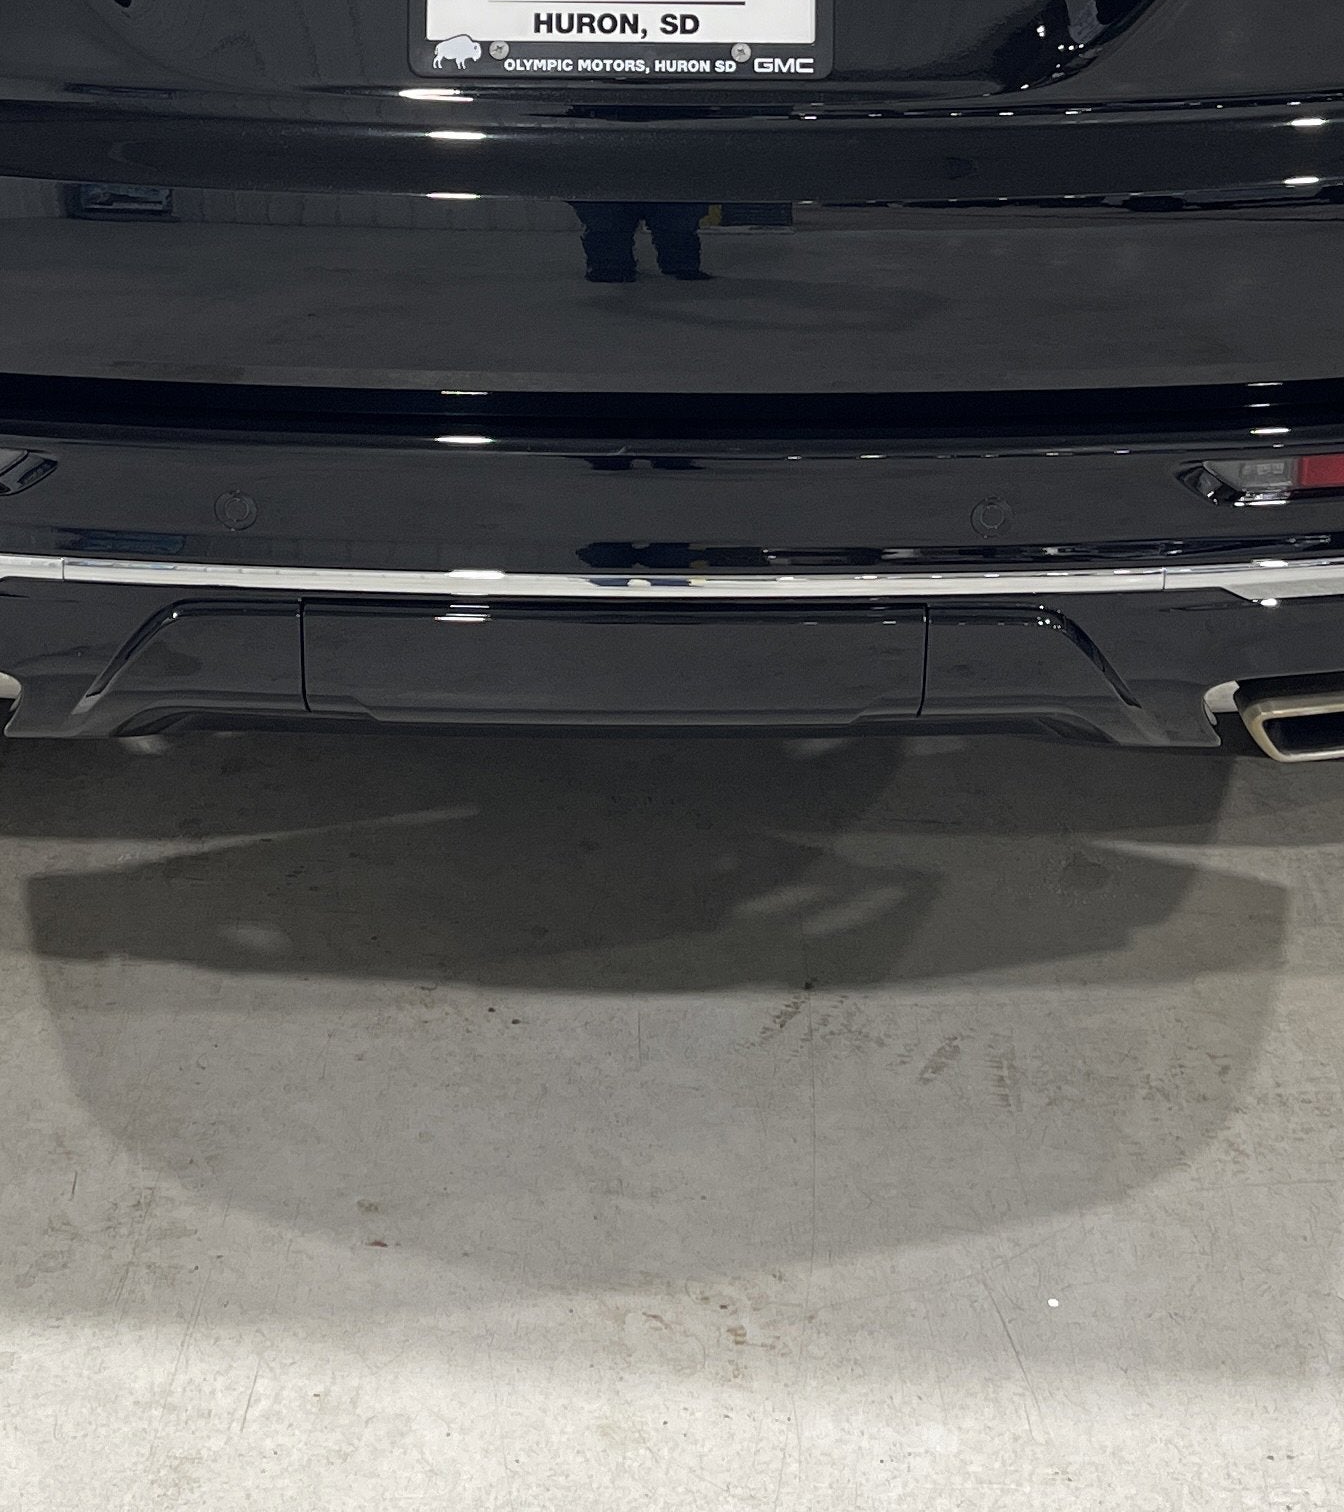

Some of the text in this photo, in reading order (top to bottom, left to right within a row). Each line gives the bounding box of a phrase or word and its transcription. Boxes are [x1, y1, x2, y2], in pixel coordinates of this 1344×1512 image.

[533, 12, 700, 39] HURON, SD
[504, 58, 737, 74] OLYMPIC MOTORS, HURON SD
[753, 57, 814, 73] GMC
